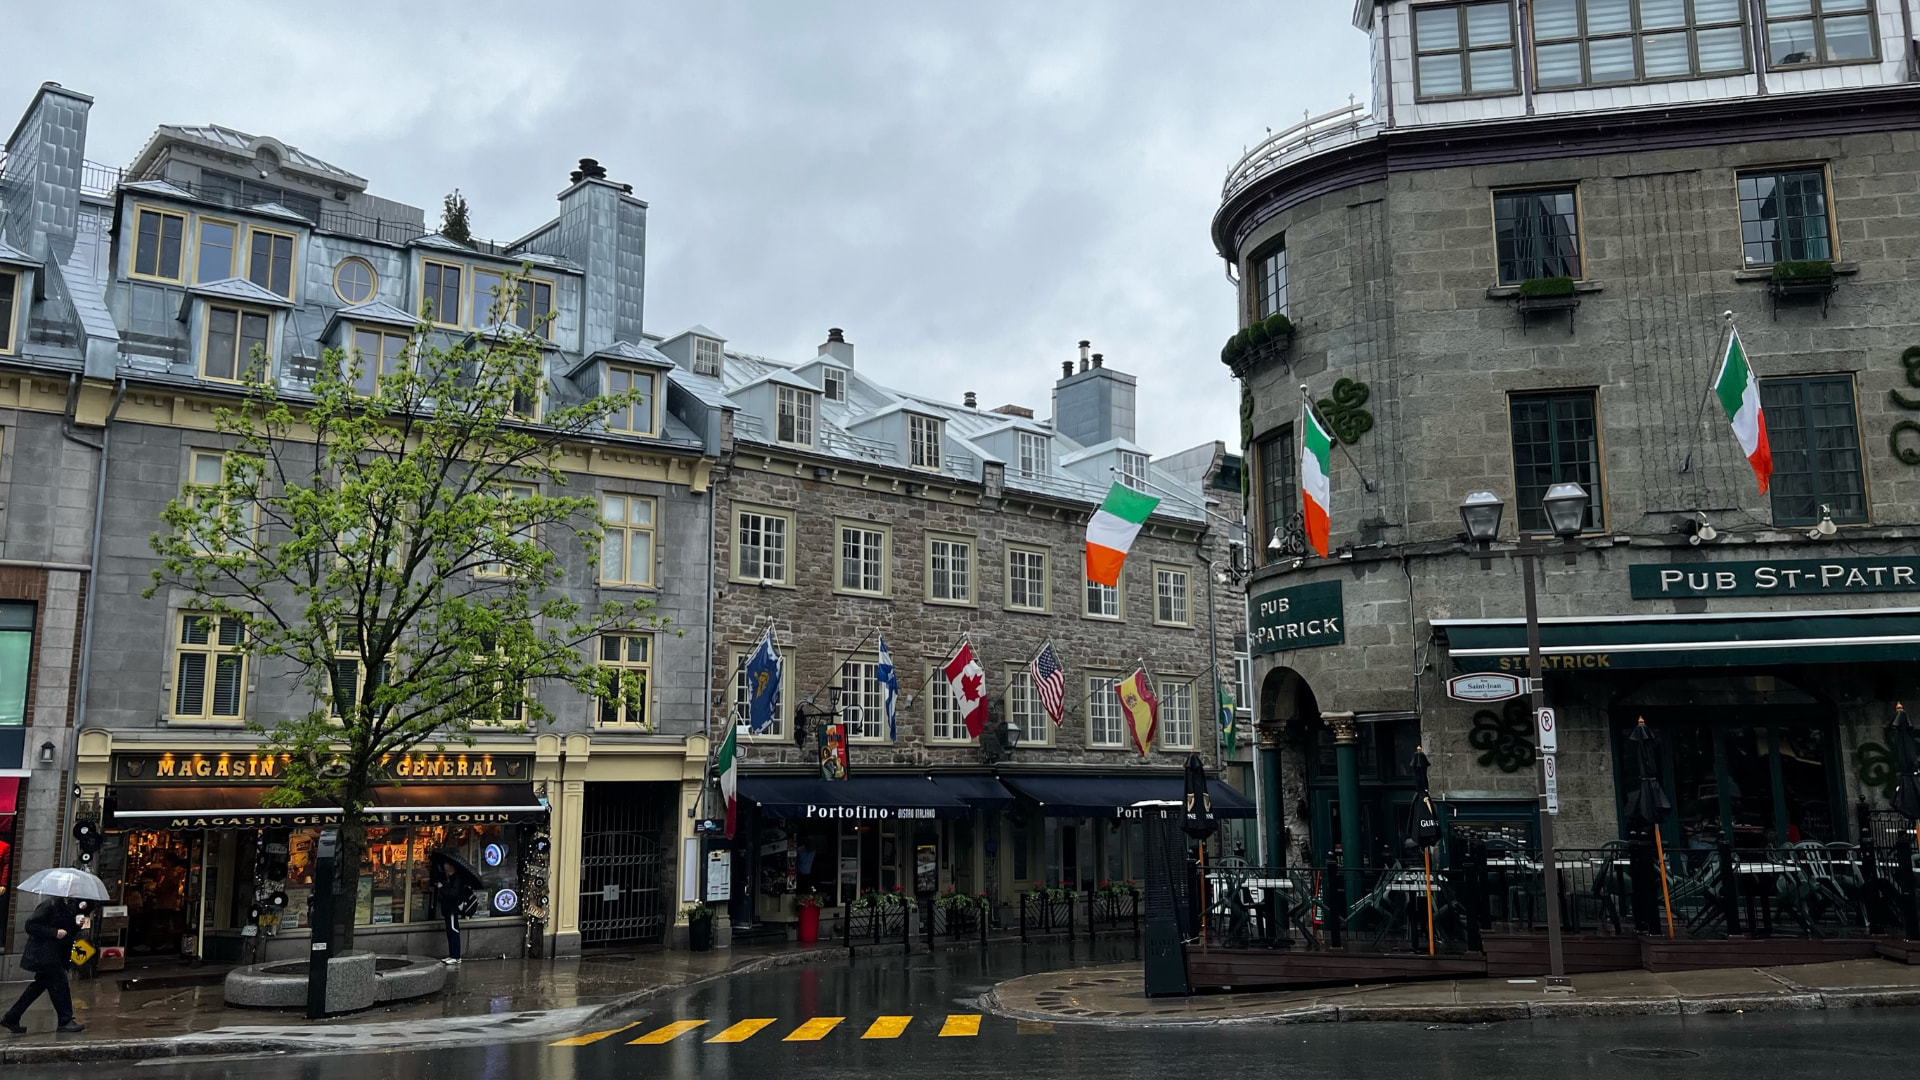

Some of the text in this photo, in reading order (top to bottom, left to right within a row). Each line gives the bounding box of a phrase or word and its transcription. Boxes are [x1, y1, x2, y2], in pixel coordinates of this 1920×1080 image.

[1660, 565, 1916, 592] PUB ST-PATR
[1260, 597, 1290, 618] PUB
[156, 759, 275, 777] MAGASIN
[171, 817, 282, 827] MAGASIN
[293, 814, 392, 825] GÉNAL
[806, 804, 889, 819] Portofino
